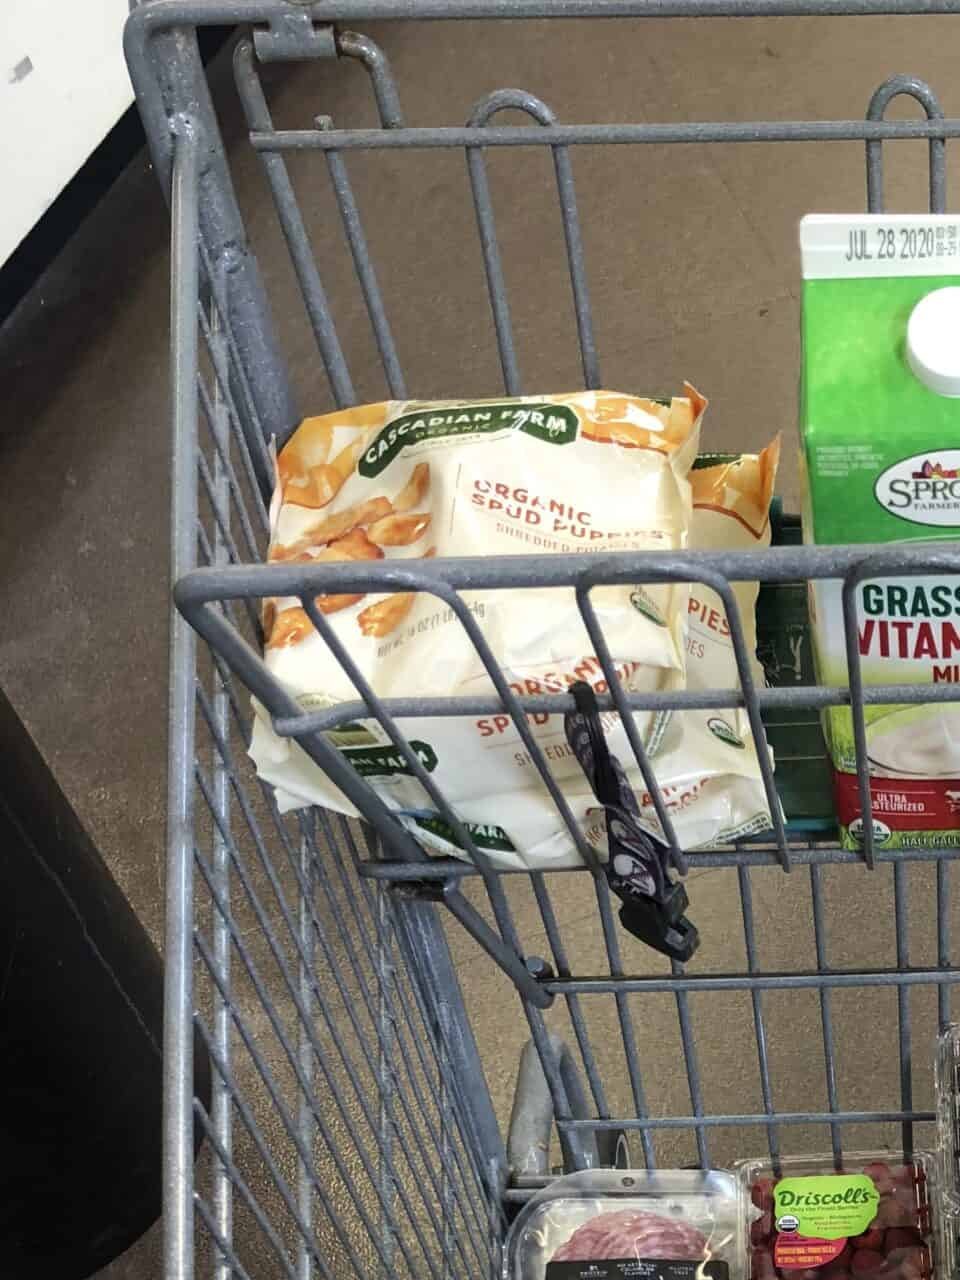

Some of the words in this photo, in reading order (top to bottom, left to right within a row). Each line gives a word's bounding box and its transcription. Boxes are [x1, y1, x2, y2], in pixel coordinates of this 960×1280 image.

[846, 229, 872, 261] JUL
[877, 228, 895, 259] 28
[899, 227, 934, 259] 2020
[365, 411, 492, 464] CASCADIAN
[471, 493, 541, 525] SPUD
[876, 794, 907, 804] ULTRA
[778, 1187, 871, 1207] Driscoll's
